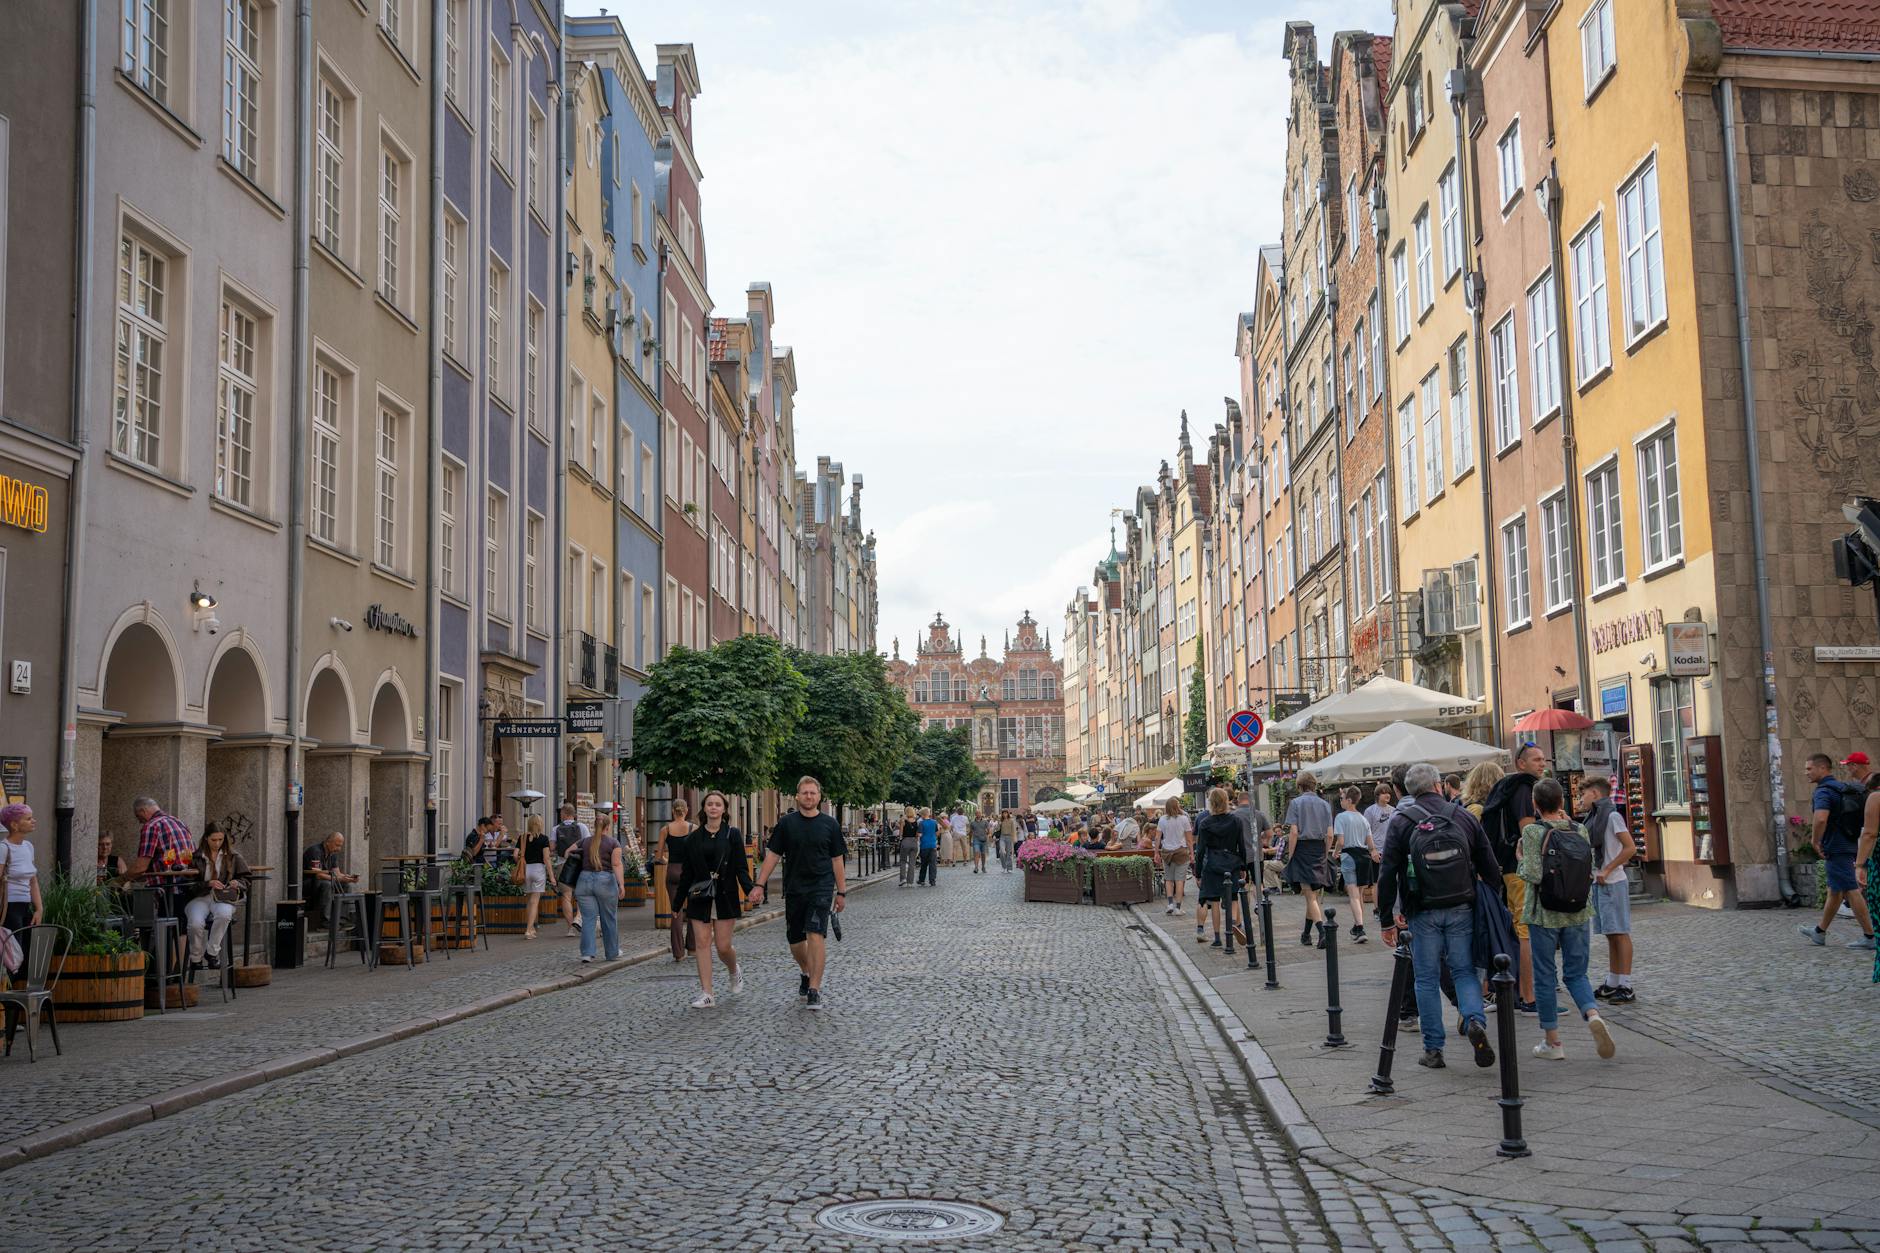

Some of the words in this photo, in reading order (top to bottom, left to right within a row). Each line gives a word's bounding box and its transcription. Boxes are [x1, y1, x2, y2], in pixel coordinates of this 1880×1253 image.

[1674, 656, 1705, 665] Kodak
[16, 664, 28, 684] 24
[1439, 705, 1477, 716] PEPSI
[498, 724, 558, 734] WIŚNIEWSKI
[1362, 765, 1392, 777] PEP
